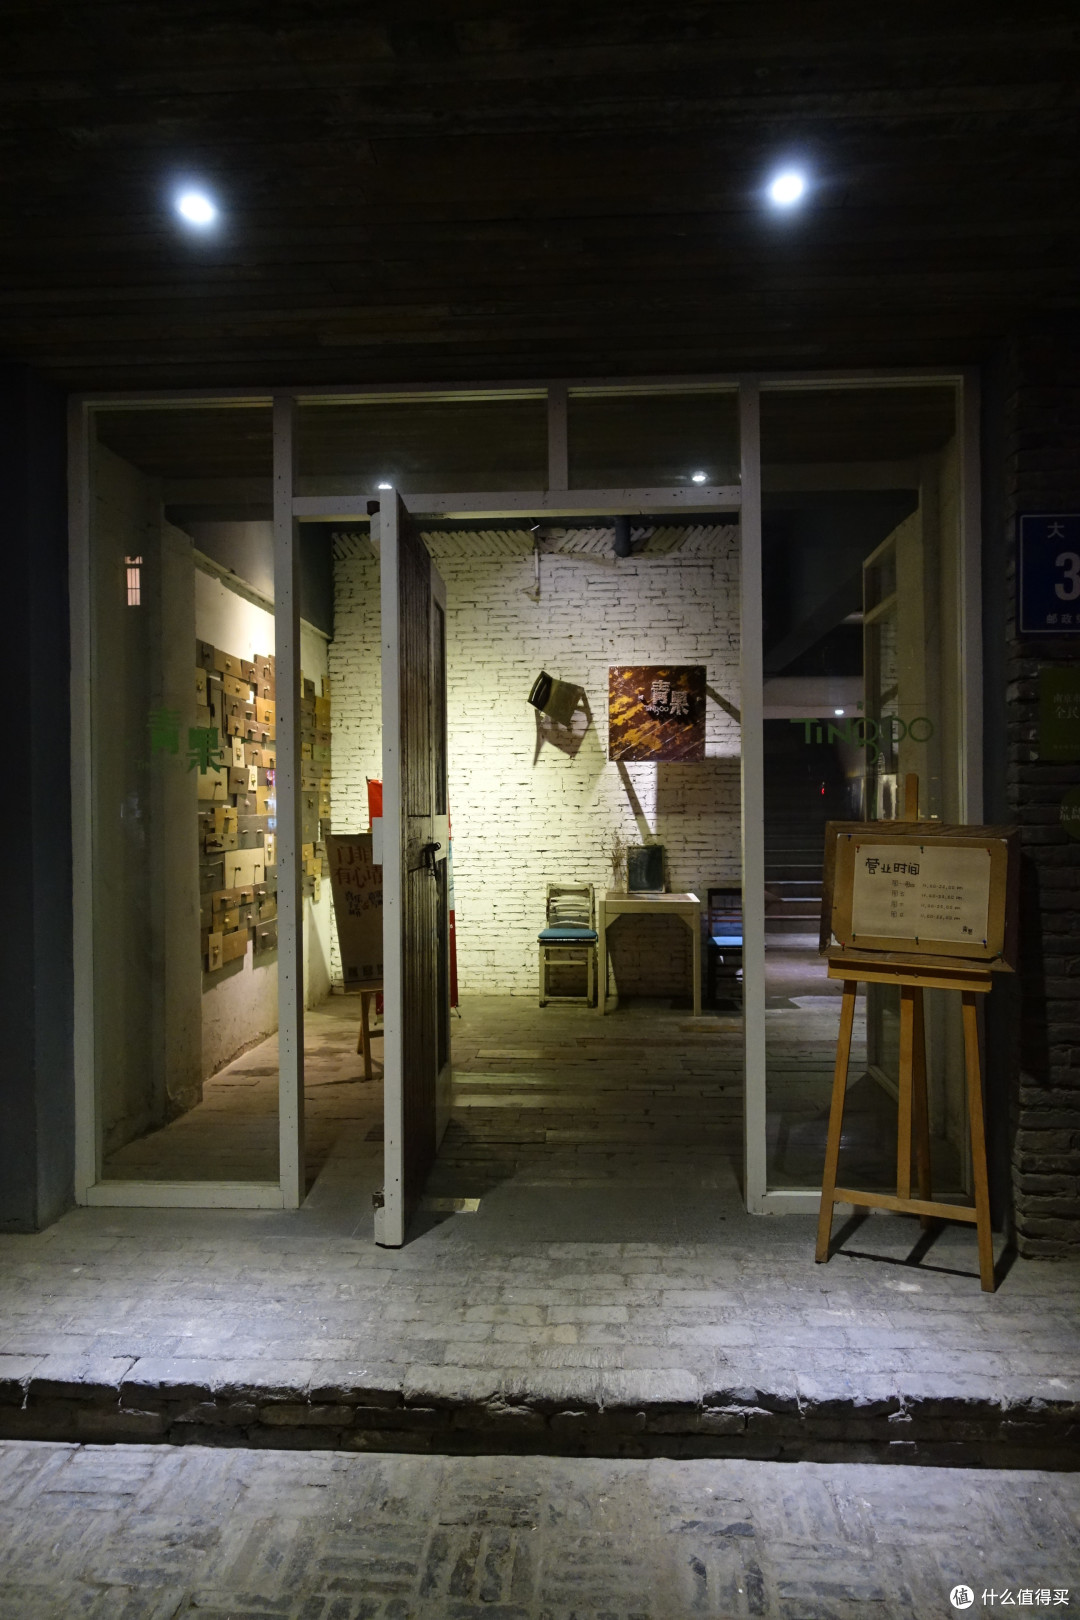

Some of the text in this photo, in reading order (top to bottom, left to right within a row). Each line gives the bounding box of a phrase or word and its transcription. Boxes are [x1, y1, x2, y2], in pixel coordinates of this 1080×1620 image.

[1047, 521, 1065, 539] 大
[1054, 551, 1080, 601] 3
[651, 679, 689, 715] 青果
[147, 706, 221, 775] 青果
[865, 857, 920, 876] 营业时间
